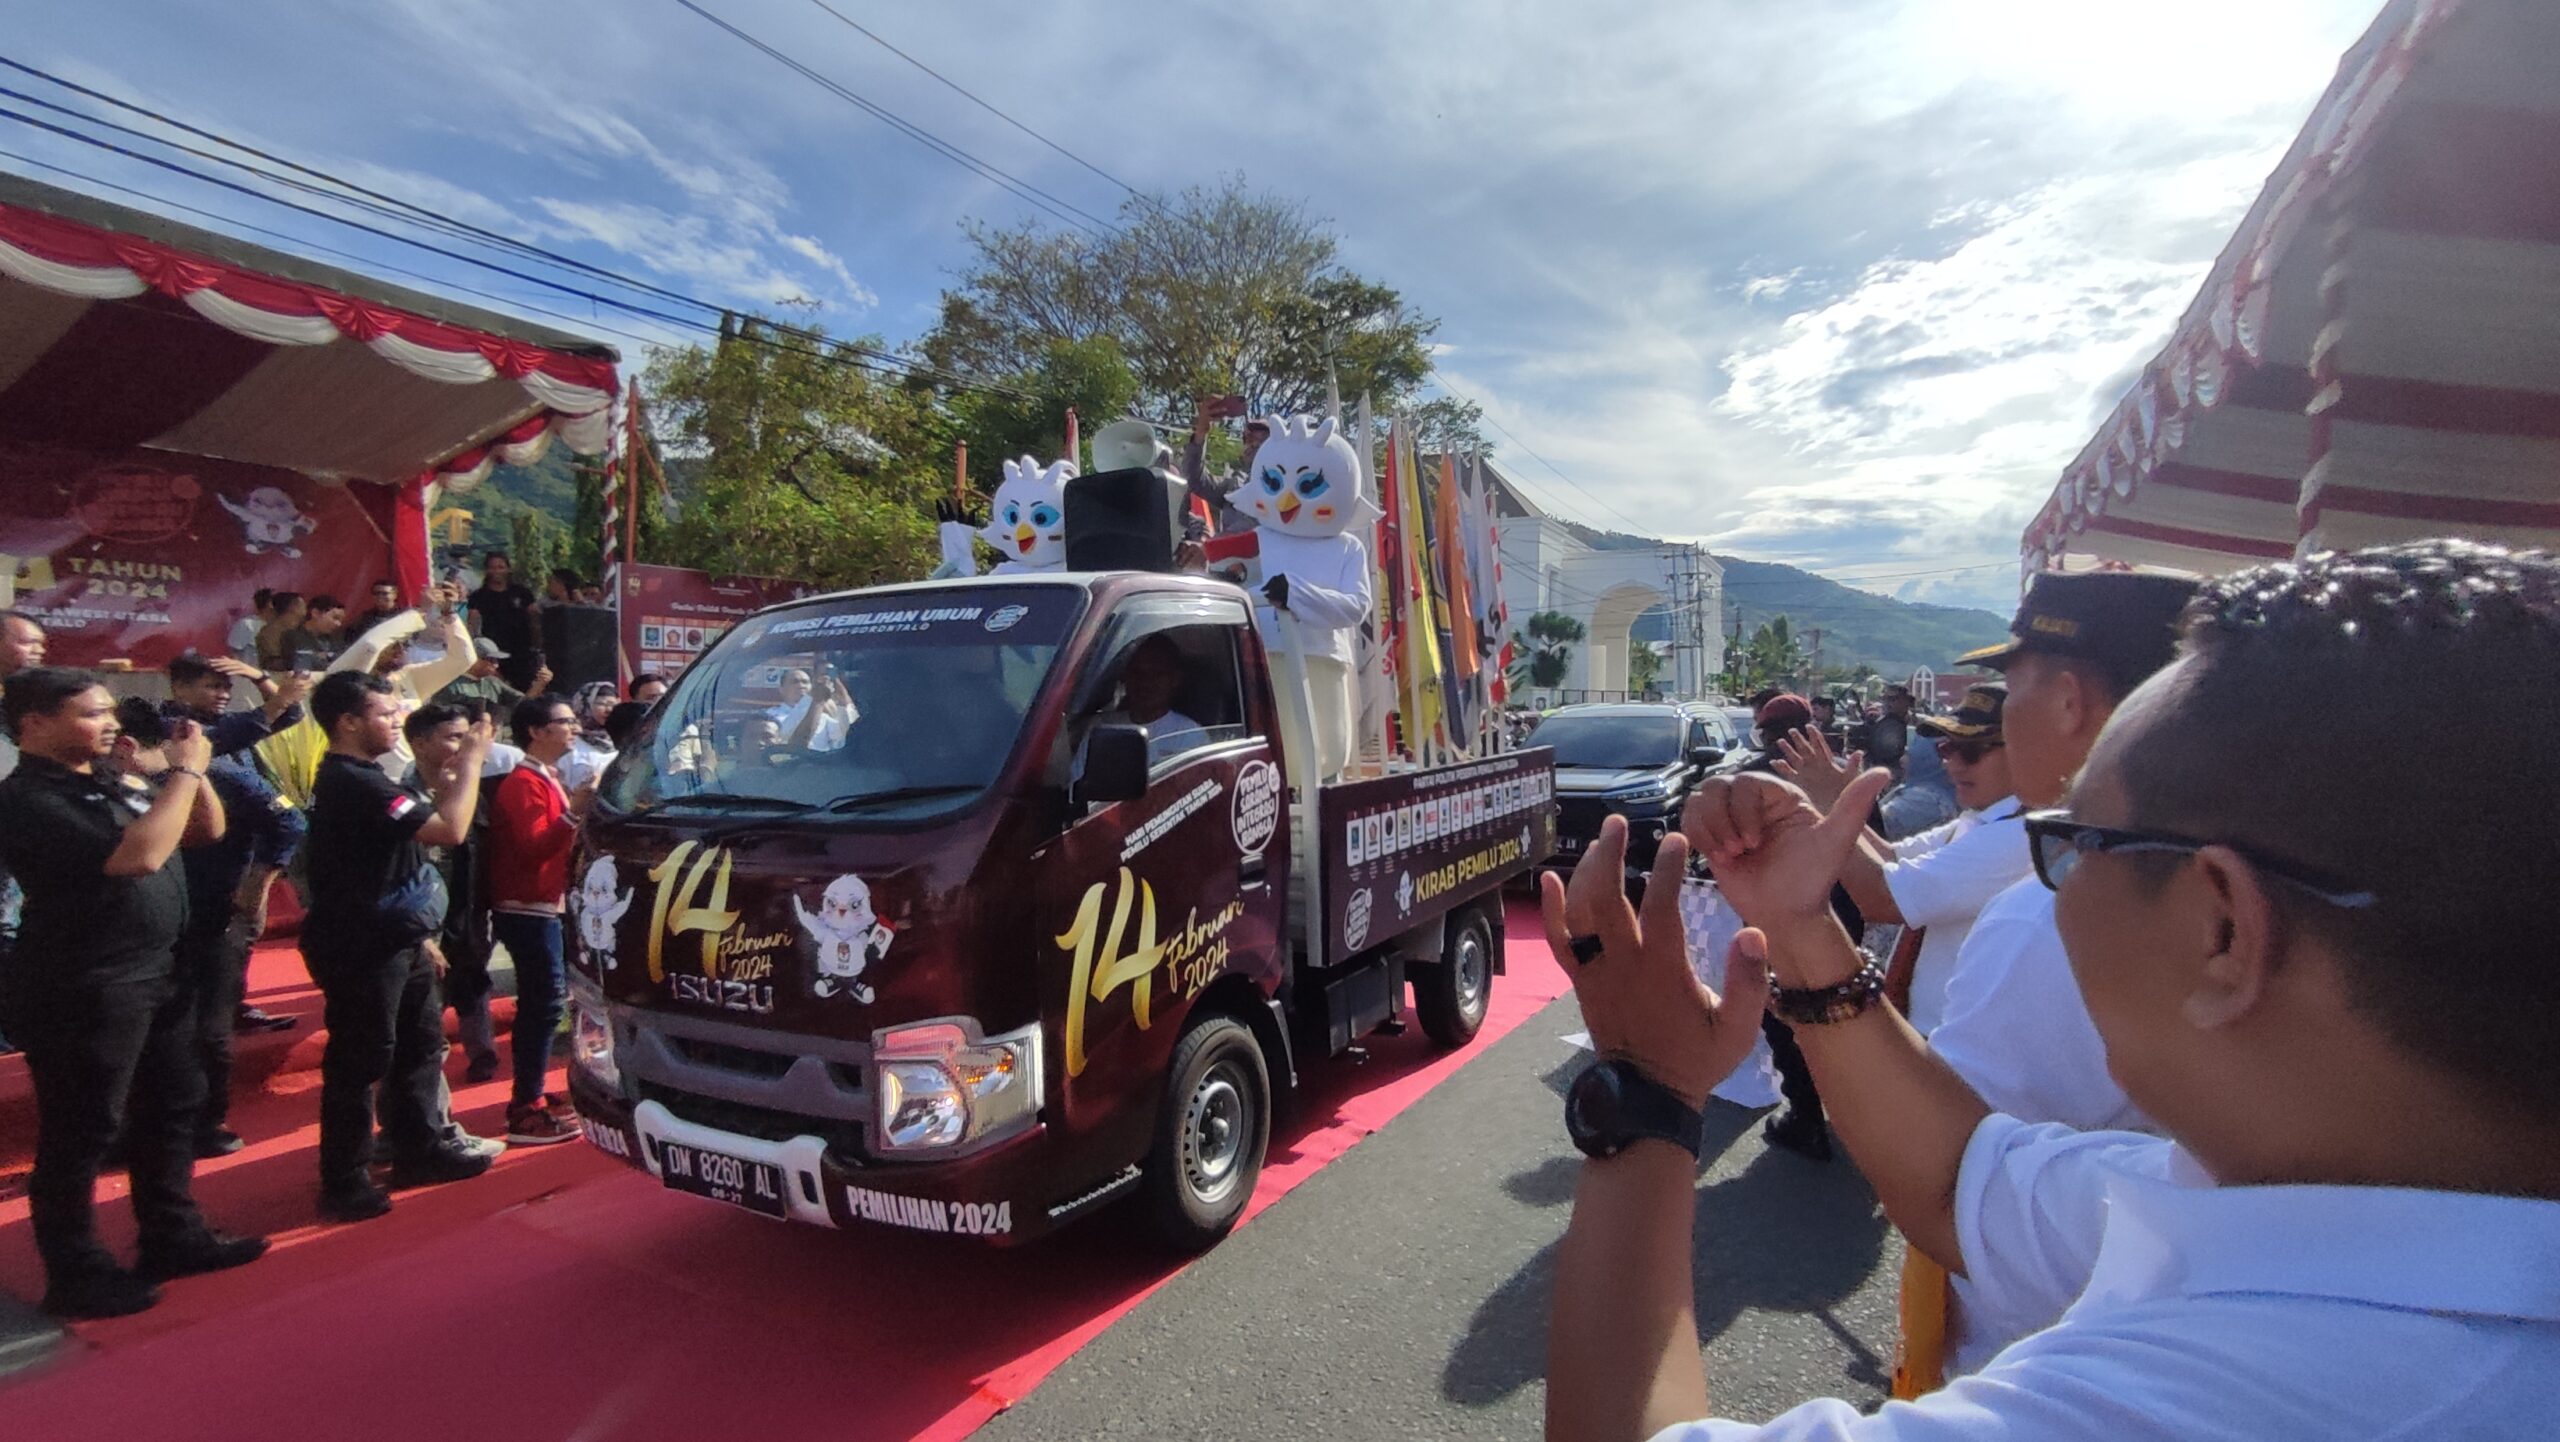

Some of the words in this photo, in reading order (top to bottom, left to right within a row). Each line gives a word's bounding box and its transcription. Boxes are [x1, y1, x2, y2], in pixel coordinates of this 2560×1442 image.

[68, 557, 182, 581] TAHUN
[87, 579, 168, 599] 2024
[824, 609, 919, 629] PEMILIHAN
[921, 607, 983, 622] UMUM
[850, 622, 930, 635] GORONTALO
[1416, 865, 1456, 903] KIRAB
[1458, 847, 1498, 884] PEMILU
[1499, 837, 1521, 866] 2024
[648, 840, 739, 983] 14
[731, 955, 773, 982] 2024
[1055, 866, 1169, 1078] 14
[1184, 936, 1230, 1001] 2024
[669, 972, 774, 1014] ISUZU
[668, 1145, 692, 1177] DM
[700, 1152, 744, 1190] 8260
[755, 1164, 778, 1200] AL
[847, 1184, 950, 1232] PEMILIHAN
[951, 1200, 1011, 1235] 2024
